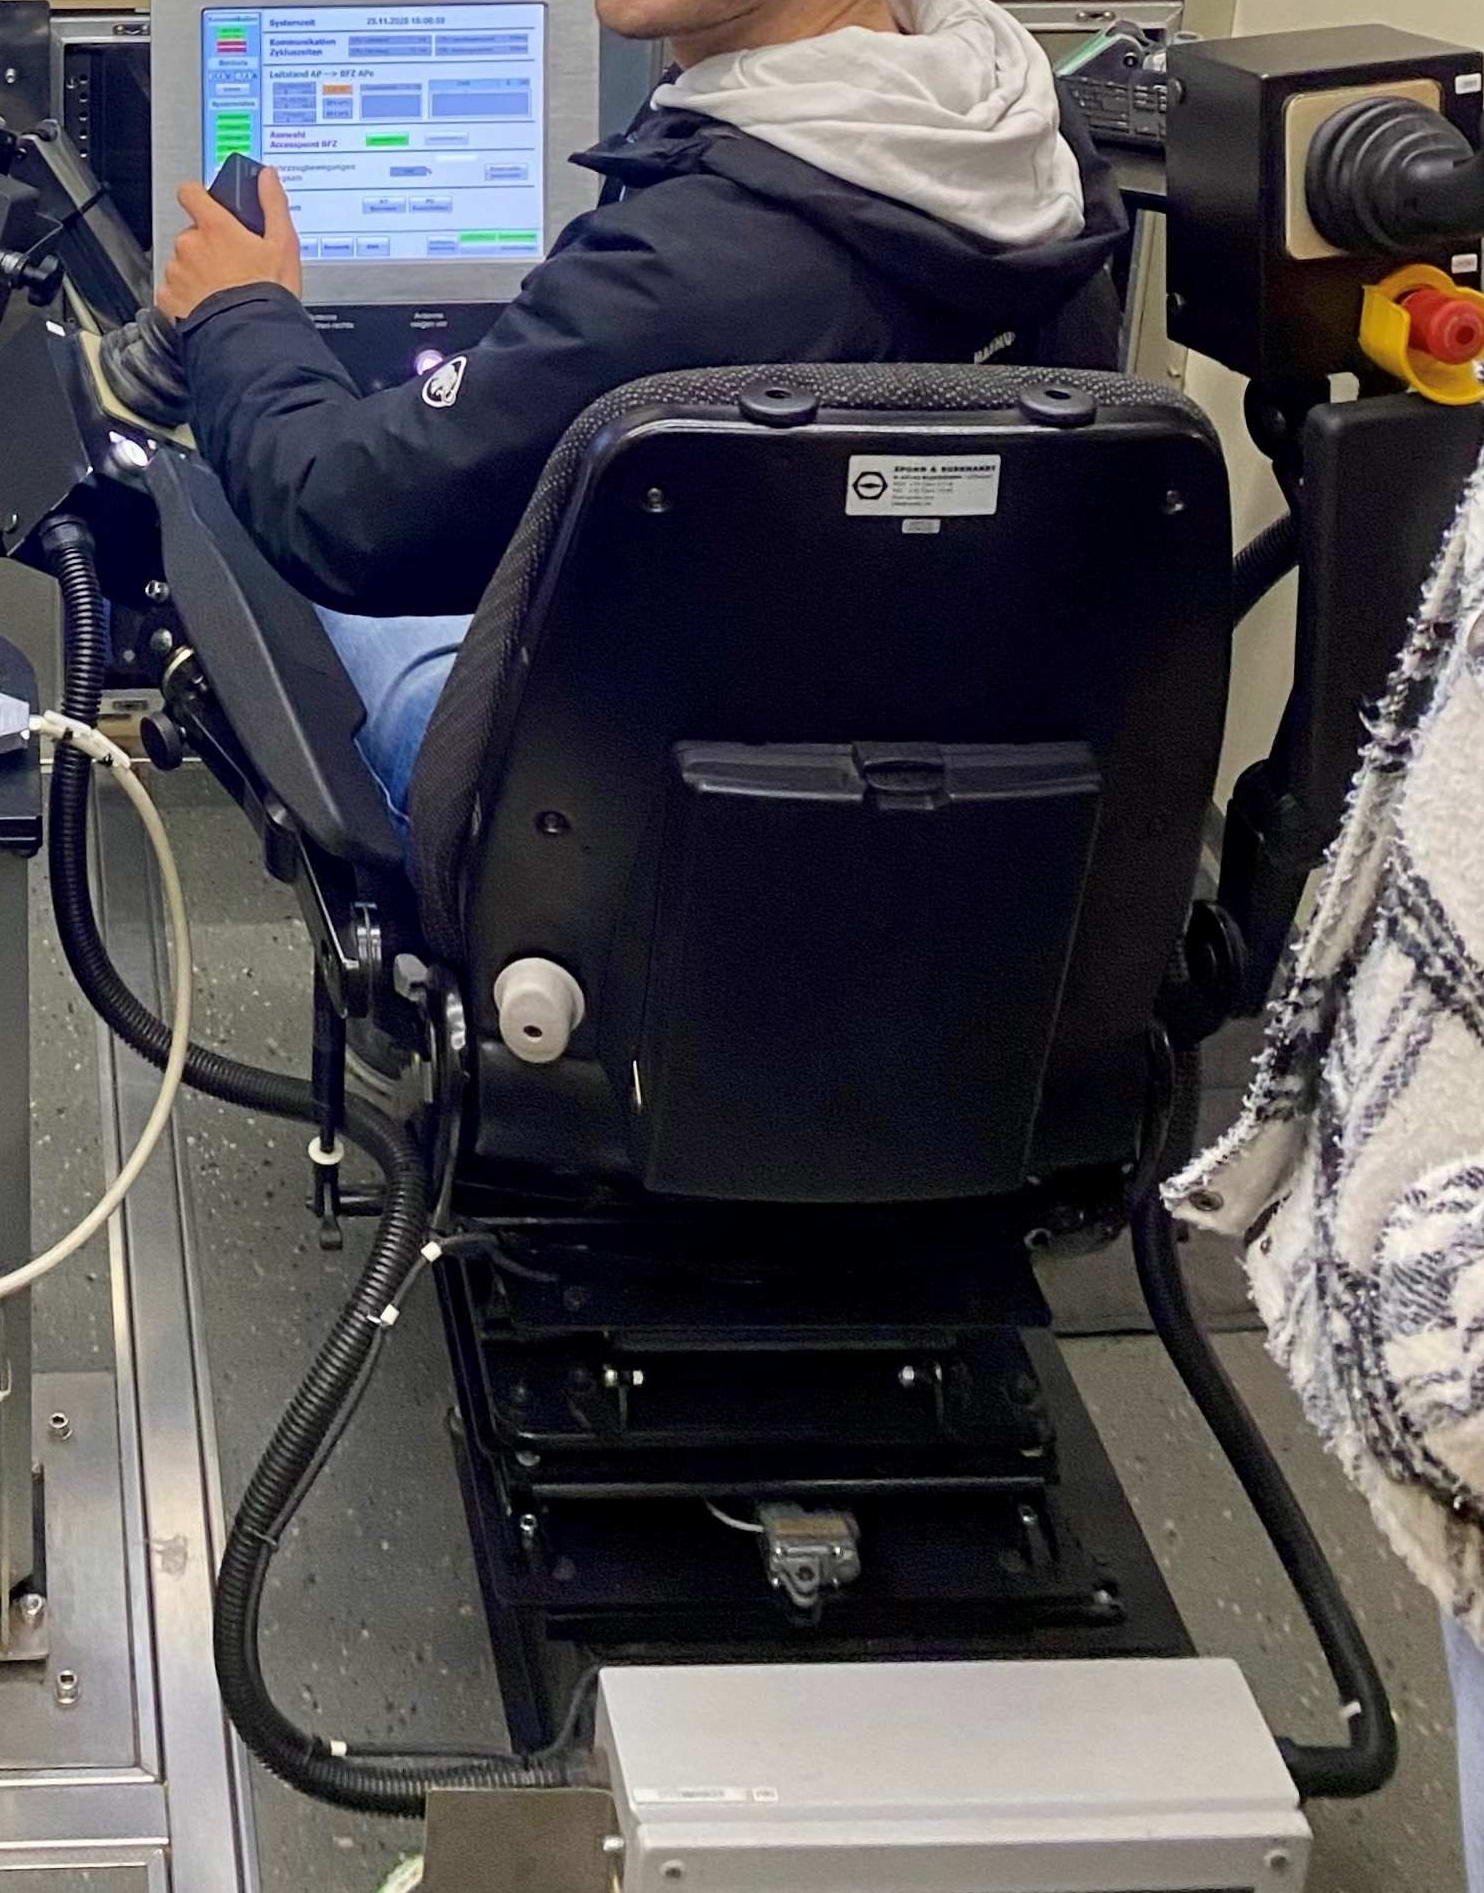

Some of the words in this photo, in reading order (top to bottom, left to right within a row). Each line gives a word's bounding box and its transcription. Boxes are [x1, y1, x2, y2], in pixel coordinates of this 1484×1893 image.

[269, 19, 315, 27] Systemzeit
[269, 38, 336, 46] Kommunikation
[269, 48, 323, 57] Zykluszeiten
[269, 70, 308, 78] Leitstand
[269, 140, 317, 149] Accesspoint
